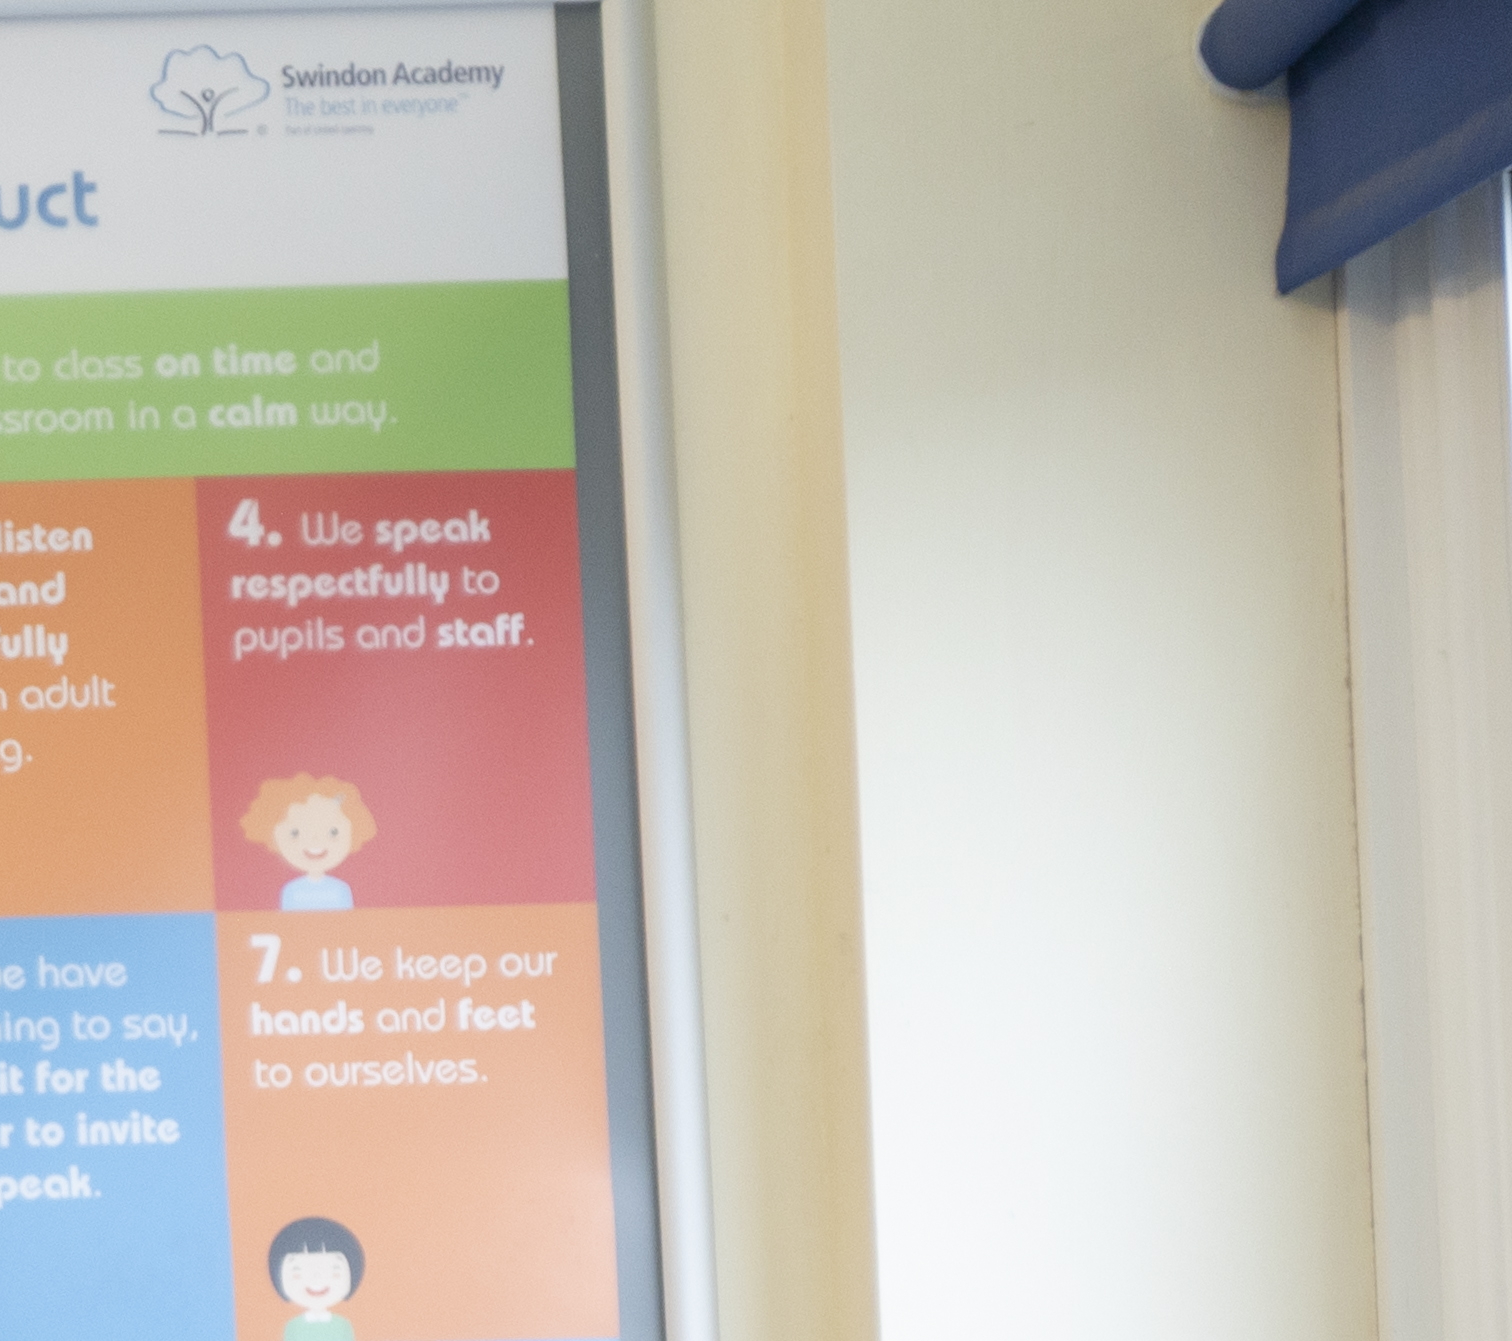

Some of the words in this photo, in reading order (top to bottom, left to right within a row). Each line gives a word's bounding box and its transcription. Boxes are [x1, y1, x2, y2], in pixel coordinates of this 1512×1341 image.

[281, 61, 387, 89] Swindon
[392, 59, 505, 91] Academy
[1, 354, 41, 383] to
[52, 347, 143, 381] class
[153, 352, 201, 379] on
[210, 342, 297, 377] time
[308, 340, 379, 374] and
[127, 400, 160, 430] in
[171, 404, 197, 430] a
[206, 393, 298, 429] calm
[310, 400, 397, 431] way.
[226, 498, 282, 547] 4.
[300, 512, 363, 546] We
[374, 508, 491, 553] speak
[229, 561, 450, 608] respectfully
[461, 566, 500, 595] to
[233, 617, 345, 660] pupils
[354, 614, 426, 650] and
[436, 612, 534, 649] staff.
[18, 674, 116, 711] adult
